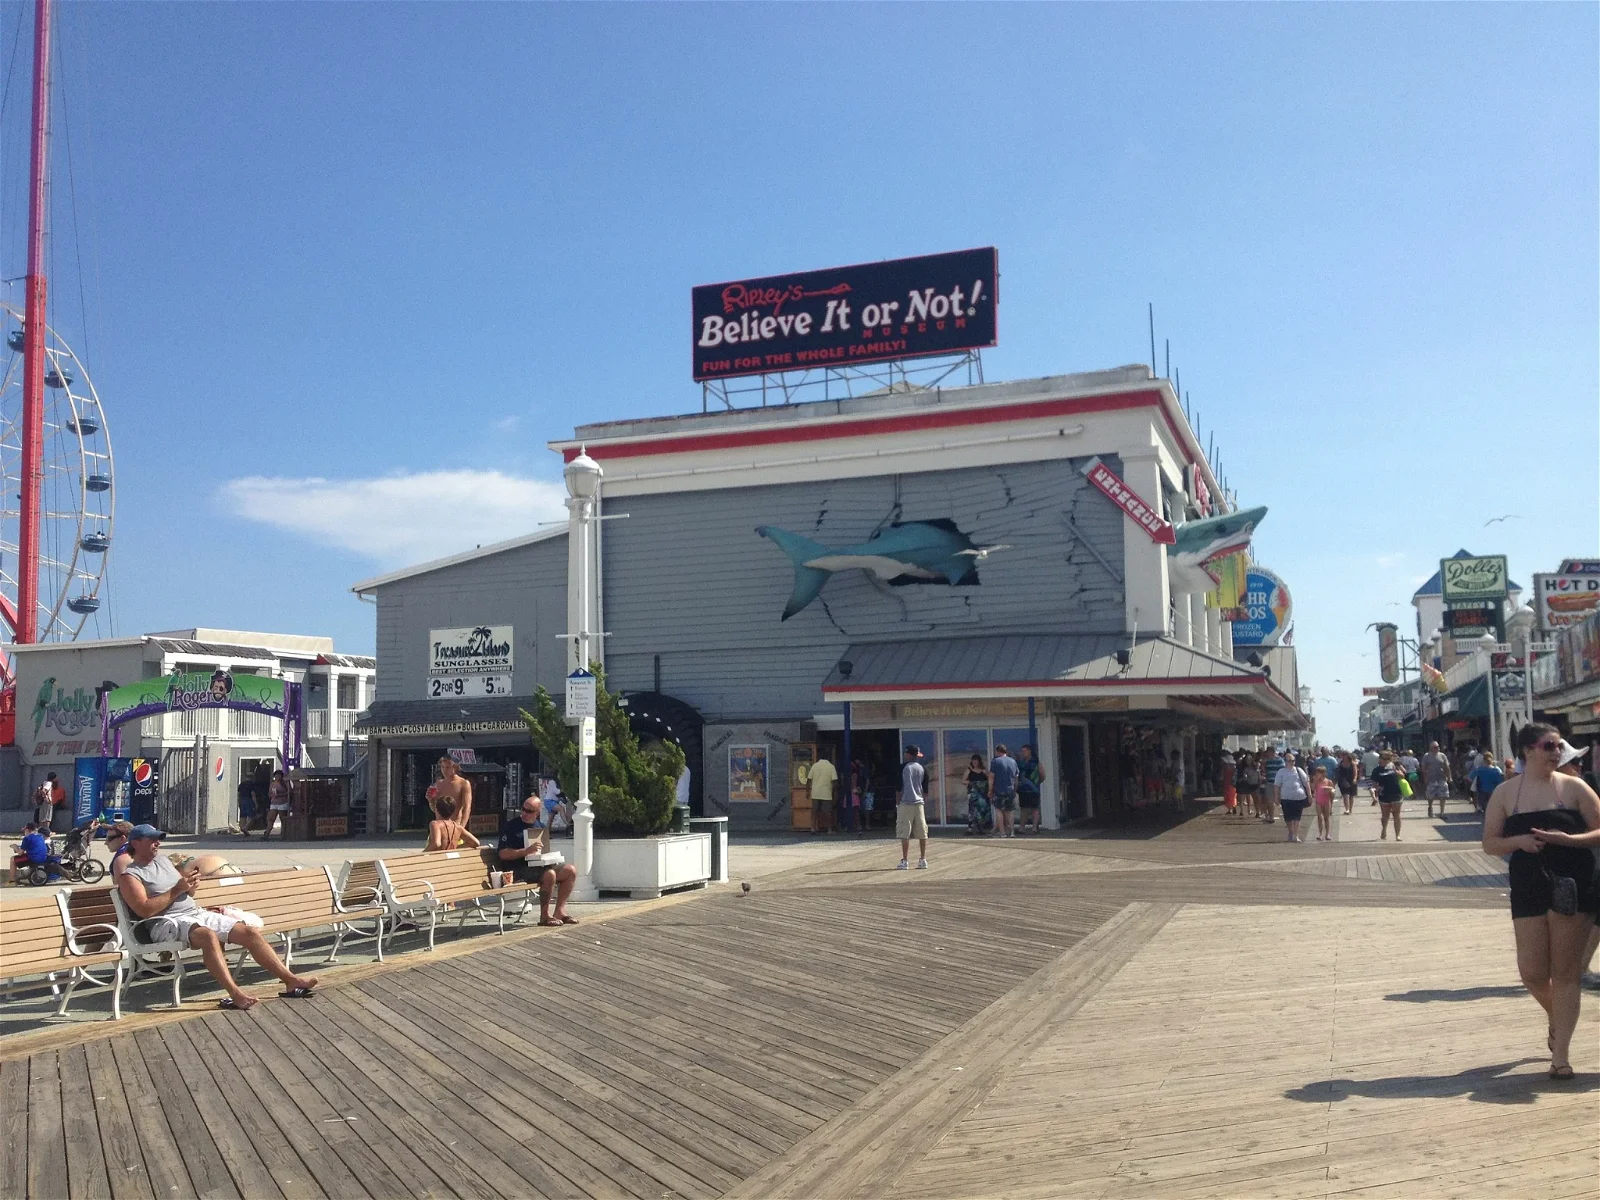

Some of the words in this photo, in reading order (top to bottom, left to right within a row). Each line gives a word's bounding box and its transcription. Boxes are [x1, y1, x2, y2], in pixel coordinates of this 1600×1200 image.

[698, 310, 812, 347] Believe
[820, 300, 851, 332] It
[862, 301, 899, 328] or
[904, 279, 982, 323] Not!
[863, 318, 967, 338] MUSEUM
[702, 360, 731, 372] FUN
[735, 356, 761, 369] FOR
[765, 353, 793, 364] THE
[796, 347, 844, 361] WHOLE
[849, 340, 906, 355] FAMILY!
[1094, 469, 1162, 532] ENTRANCE
[1248, 592, 1267, 605] HR
[1249, 606, 1267, 620] OS
[434, 658, 509, 668] SUNGLASSES
[432, 679, 441, 697] 2
[442, 683, 453, 693] FOR
[51, 687, 95, 712] Jolly
[903, 706, 939, 717] Believe
[941, 705, 951, 716] It
[952, 707, 963, 716] or
[369, 726, 383, 735] BAN
[386, 725, 403, 734] REVO
[408, 724, 429, 733] COSTA
[430, 723, 442, 733] DEL
[462, 722, 482, 731] BOLLE
[487, 720, 527, 730] GARGOYLES
[77, 774, 94, 819] AQUAFINA
